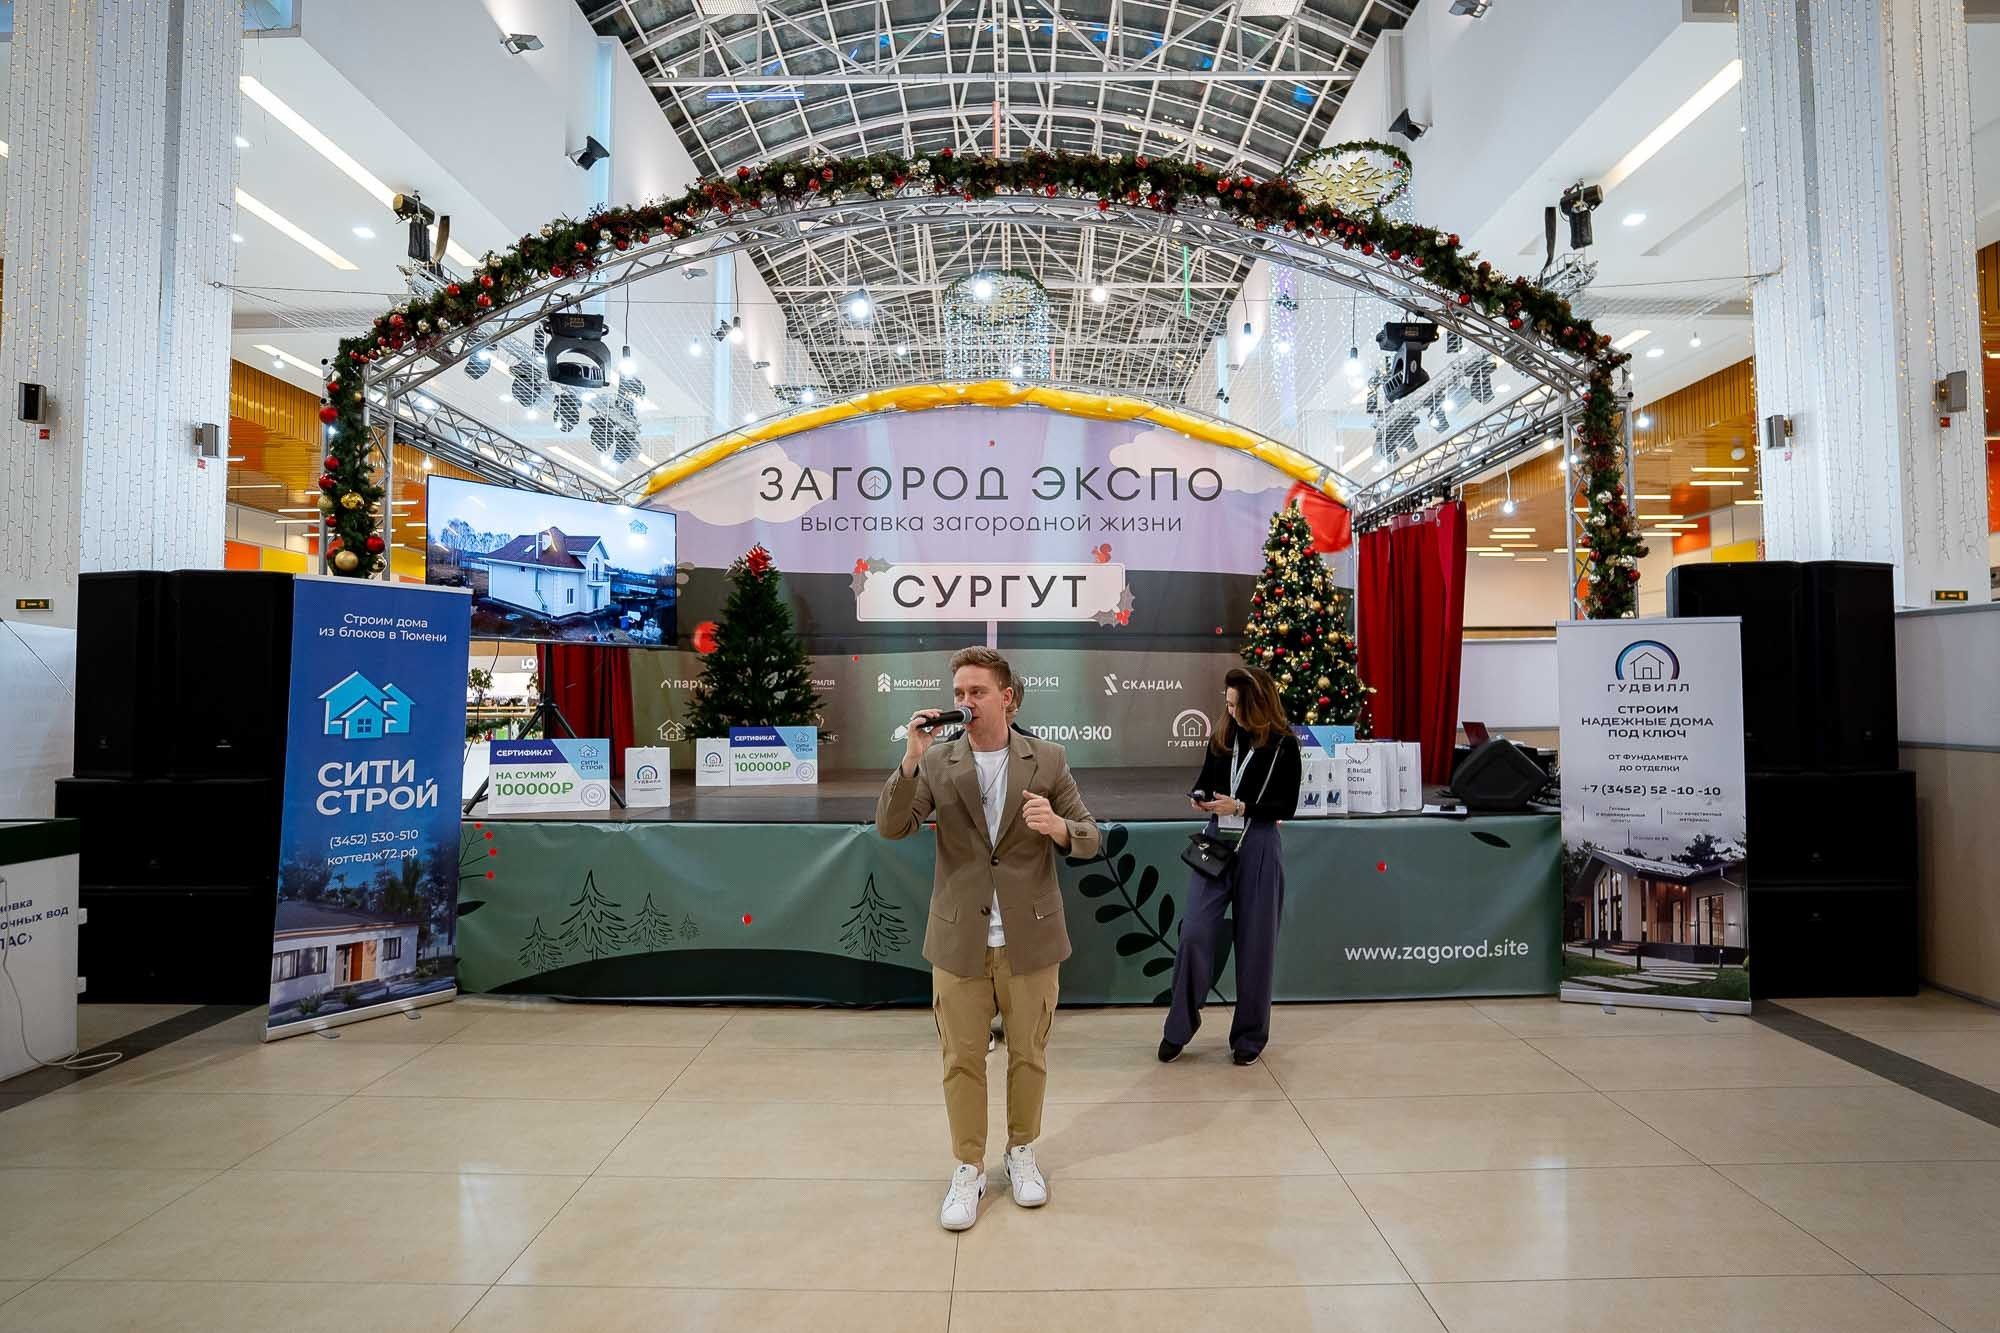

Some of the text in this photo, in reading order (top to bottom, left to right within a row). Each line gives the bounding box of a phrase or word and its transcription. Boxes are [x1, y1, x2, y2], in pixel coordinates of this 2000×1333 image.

[759, 466, 1223, 501] ЗАГОРОД ЭКСПО
[801, 512, 1183, 537] выставка загородной жизни
[892, 575, 1087, 608] СУРГУТ
[343, 613, 428, 628] Строим дома
[319, 627, 447, 643] из блоков в Тюмени
[894, 679, 941, 688] МОНОЛИТ
[1121, 680, 1183, 691] СКАНДИА
[1607, 683, 1690, 694] ГУДВИЛЛ
[1618, 705, 1679, 714] СТРОИМ
[1581, 717, 1714, 728] НАДЕЖНЫЕ ДОМА
[1608, 729, 1686, 739] ПОД КЛЮЧ
[1167, 740, 1209, 748] ГУДВИЛ
[496, 749, 554, 757] СЕРТИФИКАТ
[749, 752, 779, 760] СУММУ
[1622, 753, 1689, 762] ФУНДАМЕНТА
[317, 759, 415, 788] СИТИ
[1634, 765, 1680, 773] ОТДЕЛКИ
[495, 770, 557, 780] НА СУММУ
[316, 777, 439, 816] СТРОЙ
[329, 829, 419, 849] (3452) 530-510
[327, 846, 419, 866] коттедж72.рф
[46, 906, 69, 919] вод
[1344, 938, 1529, 964] www.zagorod.site
